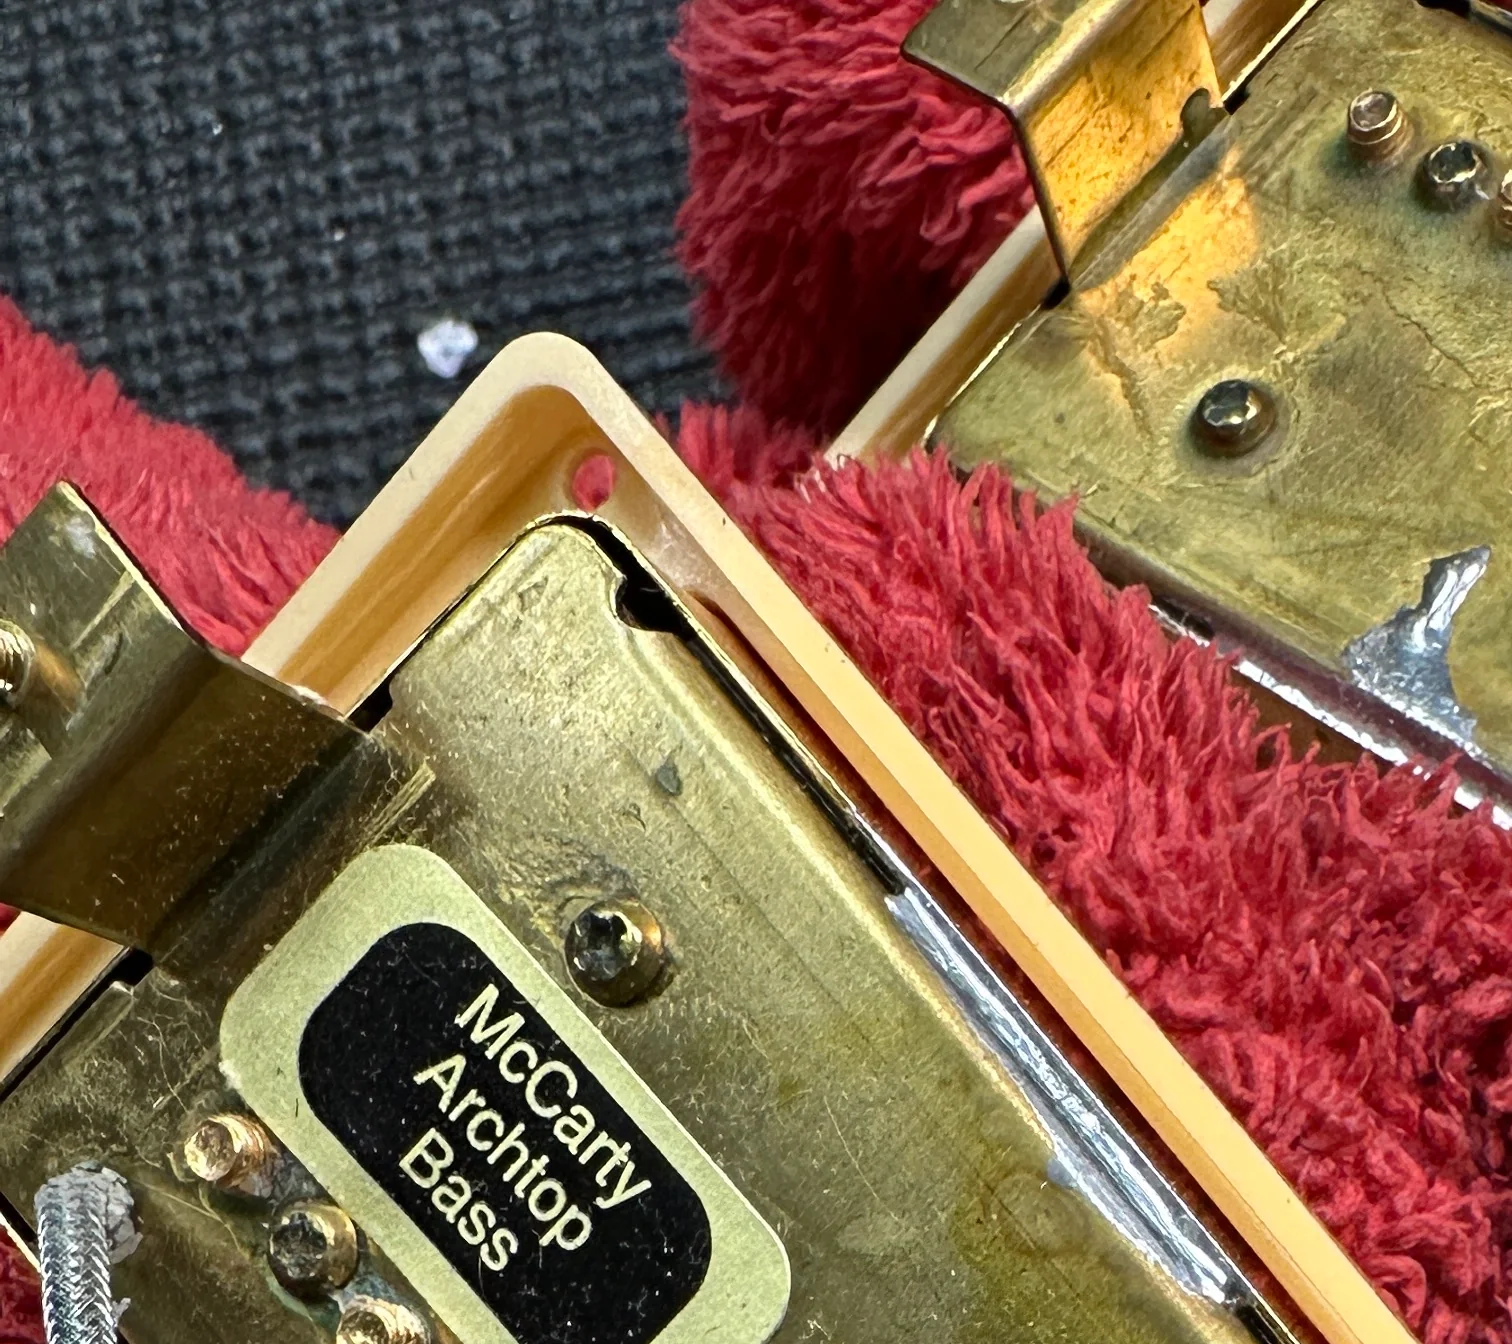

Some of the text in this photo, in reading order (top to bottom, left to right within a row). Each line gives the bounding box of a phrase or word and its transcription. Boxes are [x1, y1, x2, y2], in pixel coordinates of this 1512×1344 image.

[413, 1054, 594, 1252] Archtop
[454, 983, 653, 1210] McCarty
[398, 1127, 519, 1272] Bass
